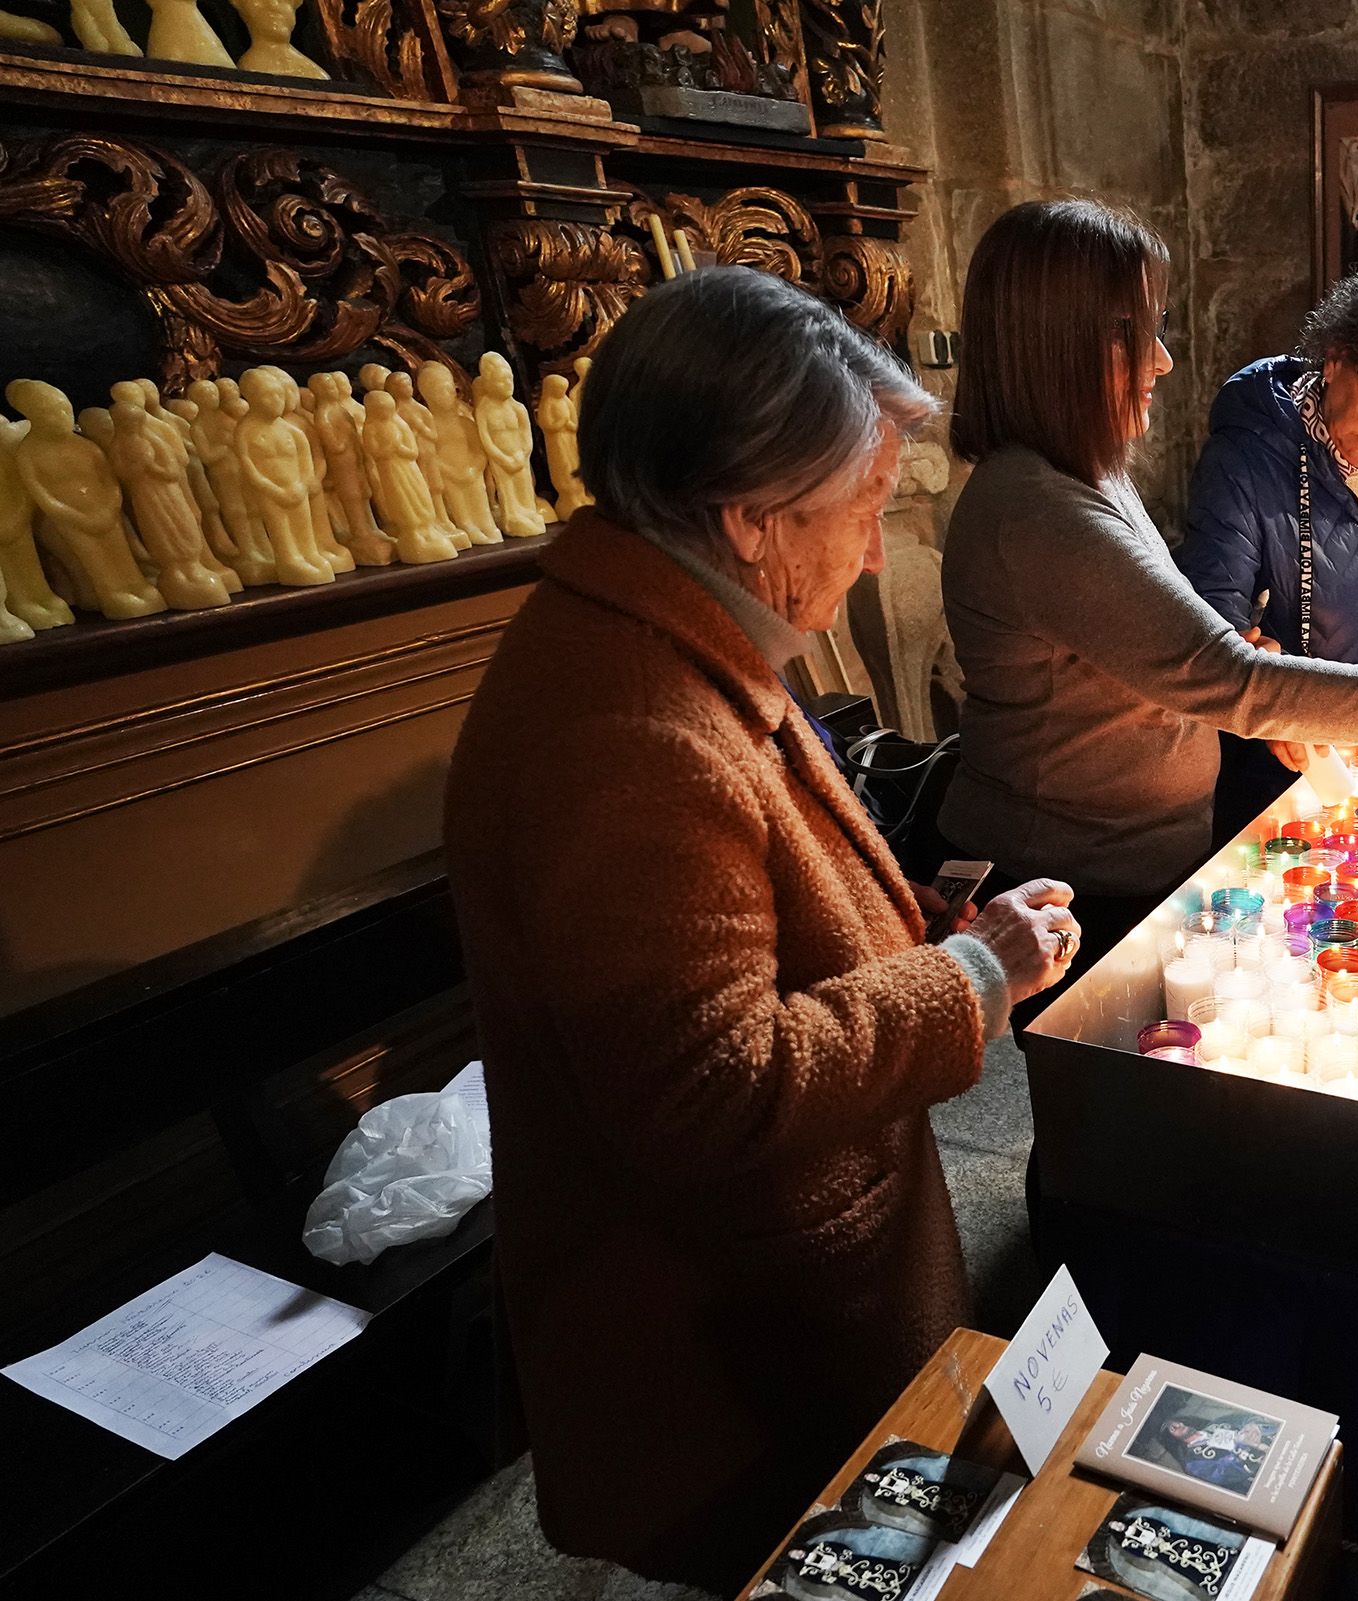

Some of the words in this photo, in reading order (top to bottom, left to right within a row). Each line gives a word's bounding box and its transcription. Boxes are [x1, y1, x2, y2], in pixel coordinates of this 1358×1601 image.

[1013, 1294, 1078, 1401] NOVENAS
[1037, 1386, 1053, 1413] 5
[1051, 1367, 1070, 1393] €
